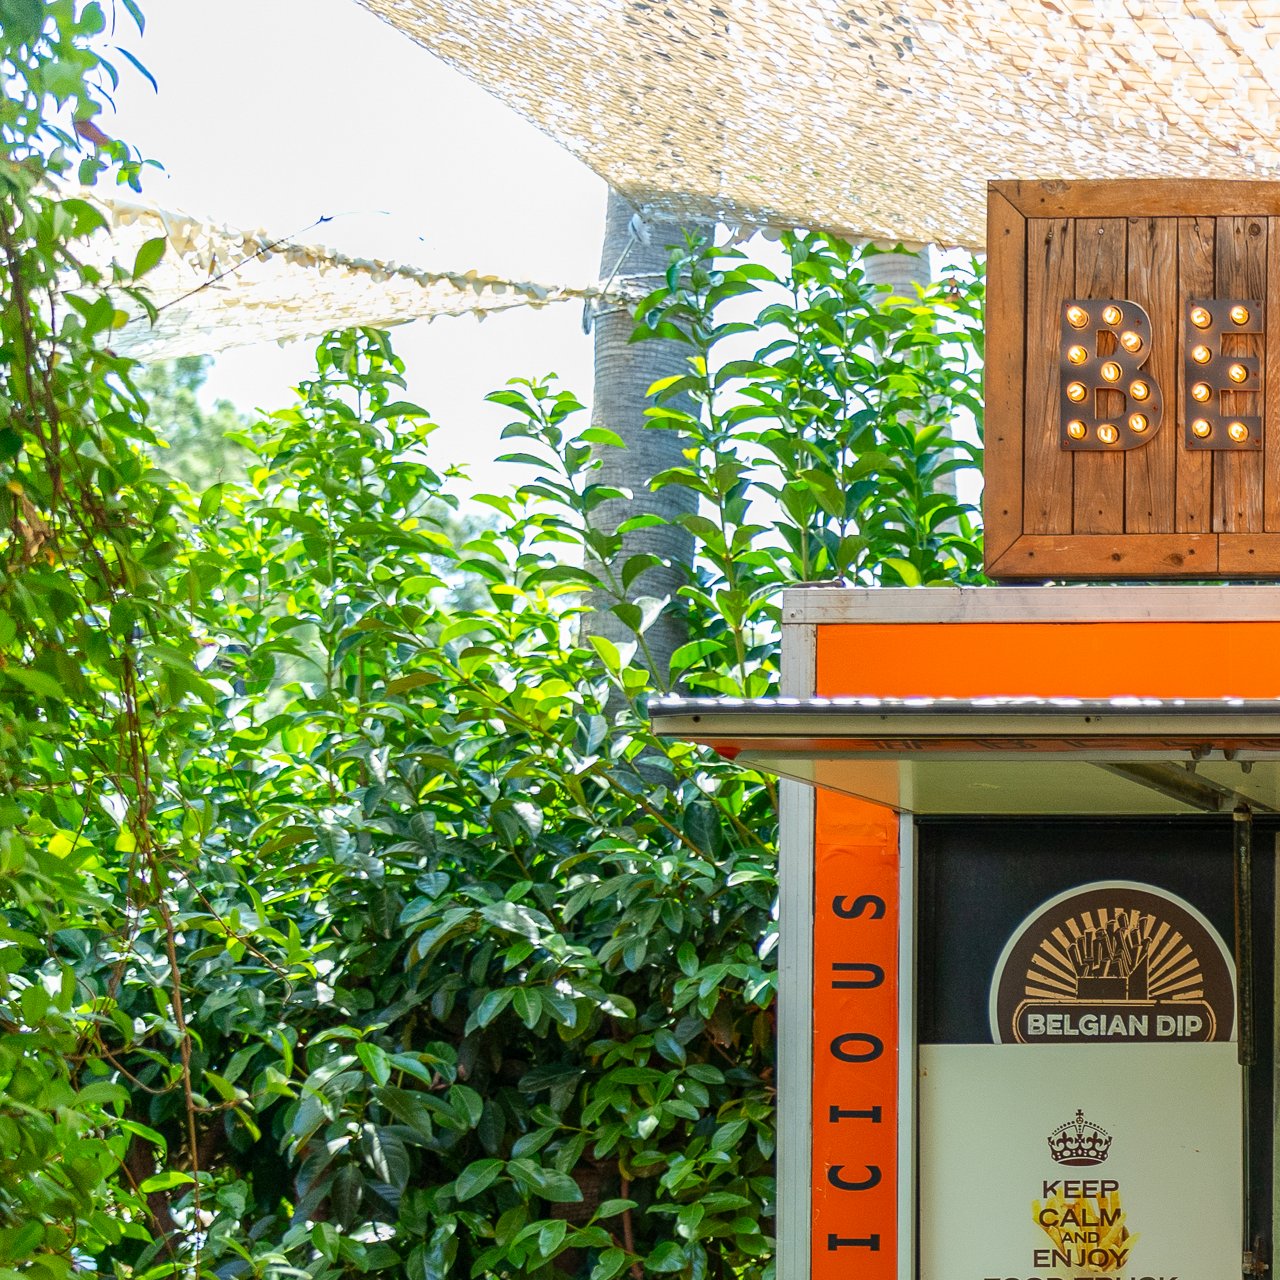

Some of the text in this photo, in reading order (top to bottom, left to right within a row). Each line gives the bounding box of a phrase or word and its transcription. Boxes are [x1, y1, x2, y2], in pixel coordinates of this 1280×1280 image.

[1027, 1013, 1203, 1037] BELGIAN DIP
[1042, 1180, 1120, 1199] KEEP
[1038, 1208, 1122, 1227] CALM
[1061, 1231, 1100, 1244] AND
[1033, 1248, 1130, 1268] ENJOY
